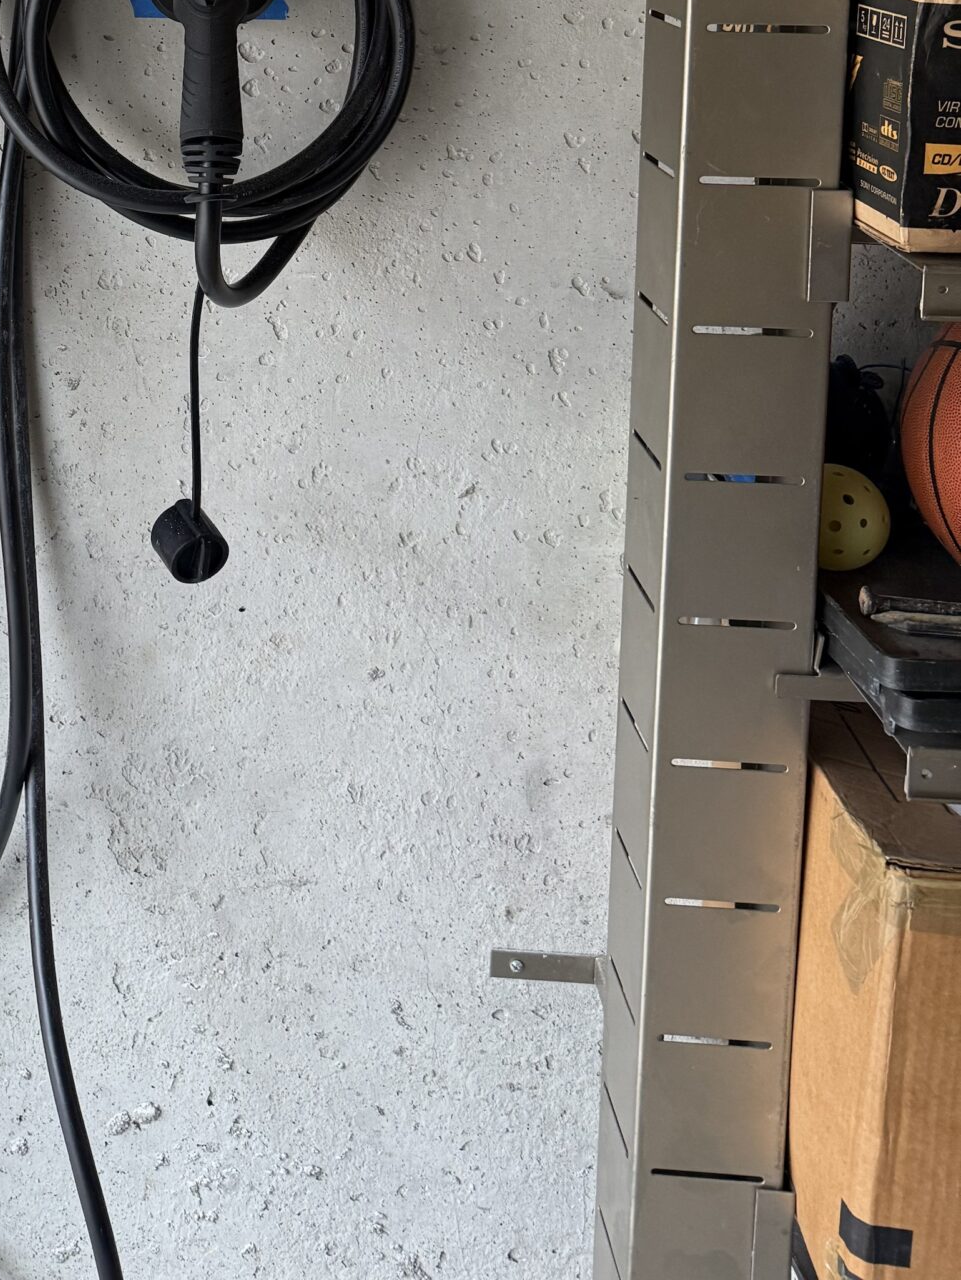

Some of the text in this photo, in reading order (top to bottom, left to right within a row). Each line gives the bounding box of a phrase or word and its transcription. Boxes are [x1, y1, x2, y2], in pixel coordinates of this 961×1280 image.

[860, 10, 865, 23] 5
[882, 17, 890, 31] 24
[881, 120, 898, 140] dts
[857, 147, 878, 165] Precision
[932, 154, 961, 166] CD/
